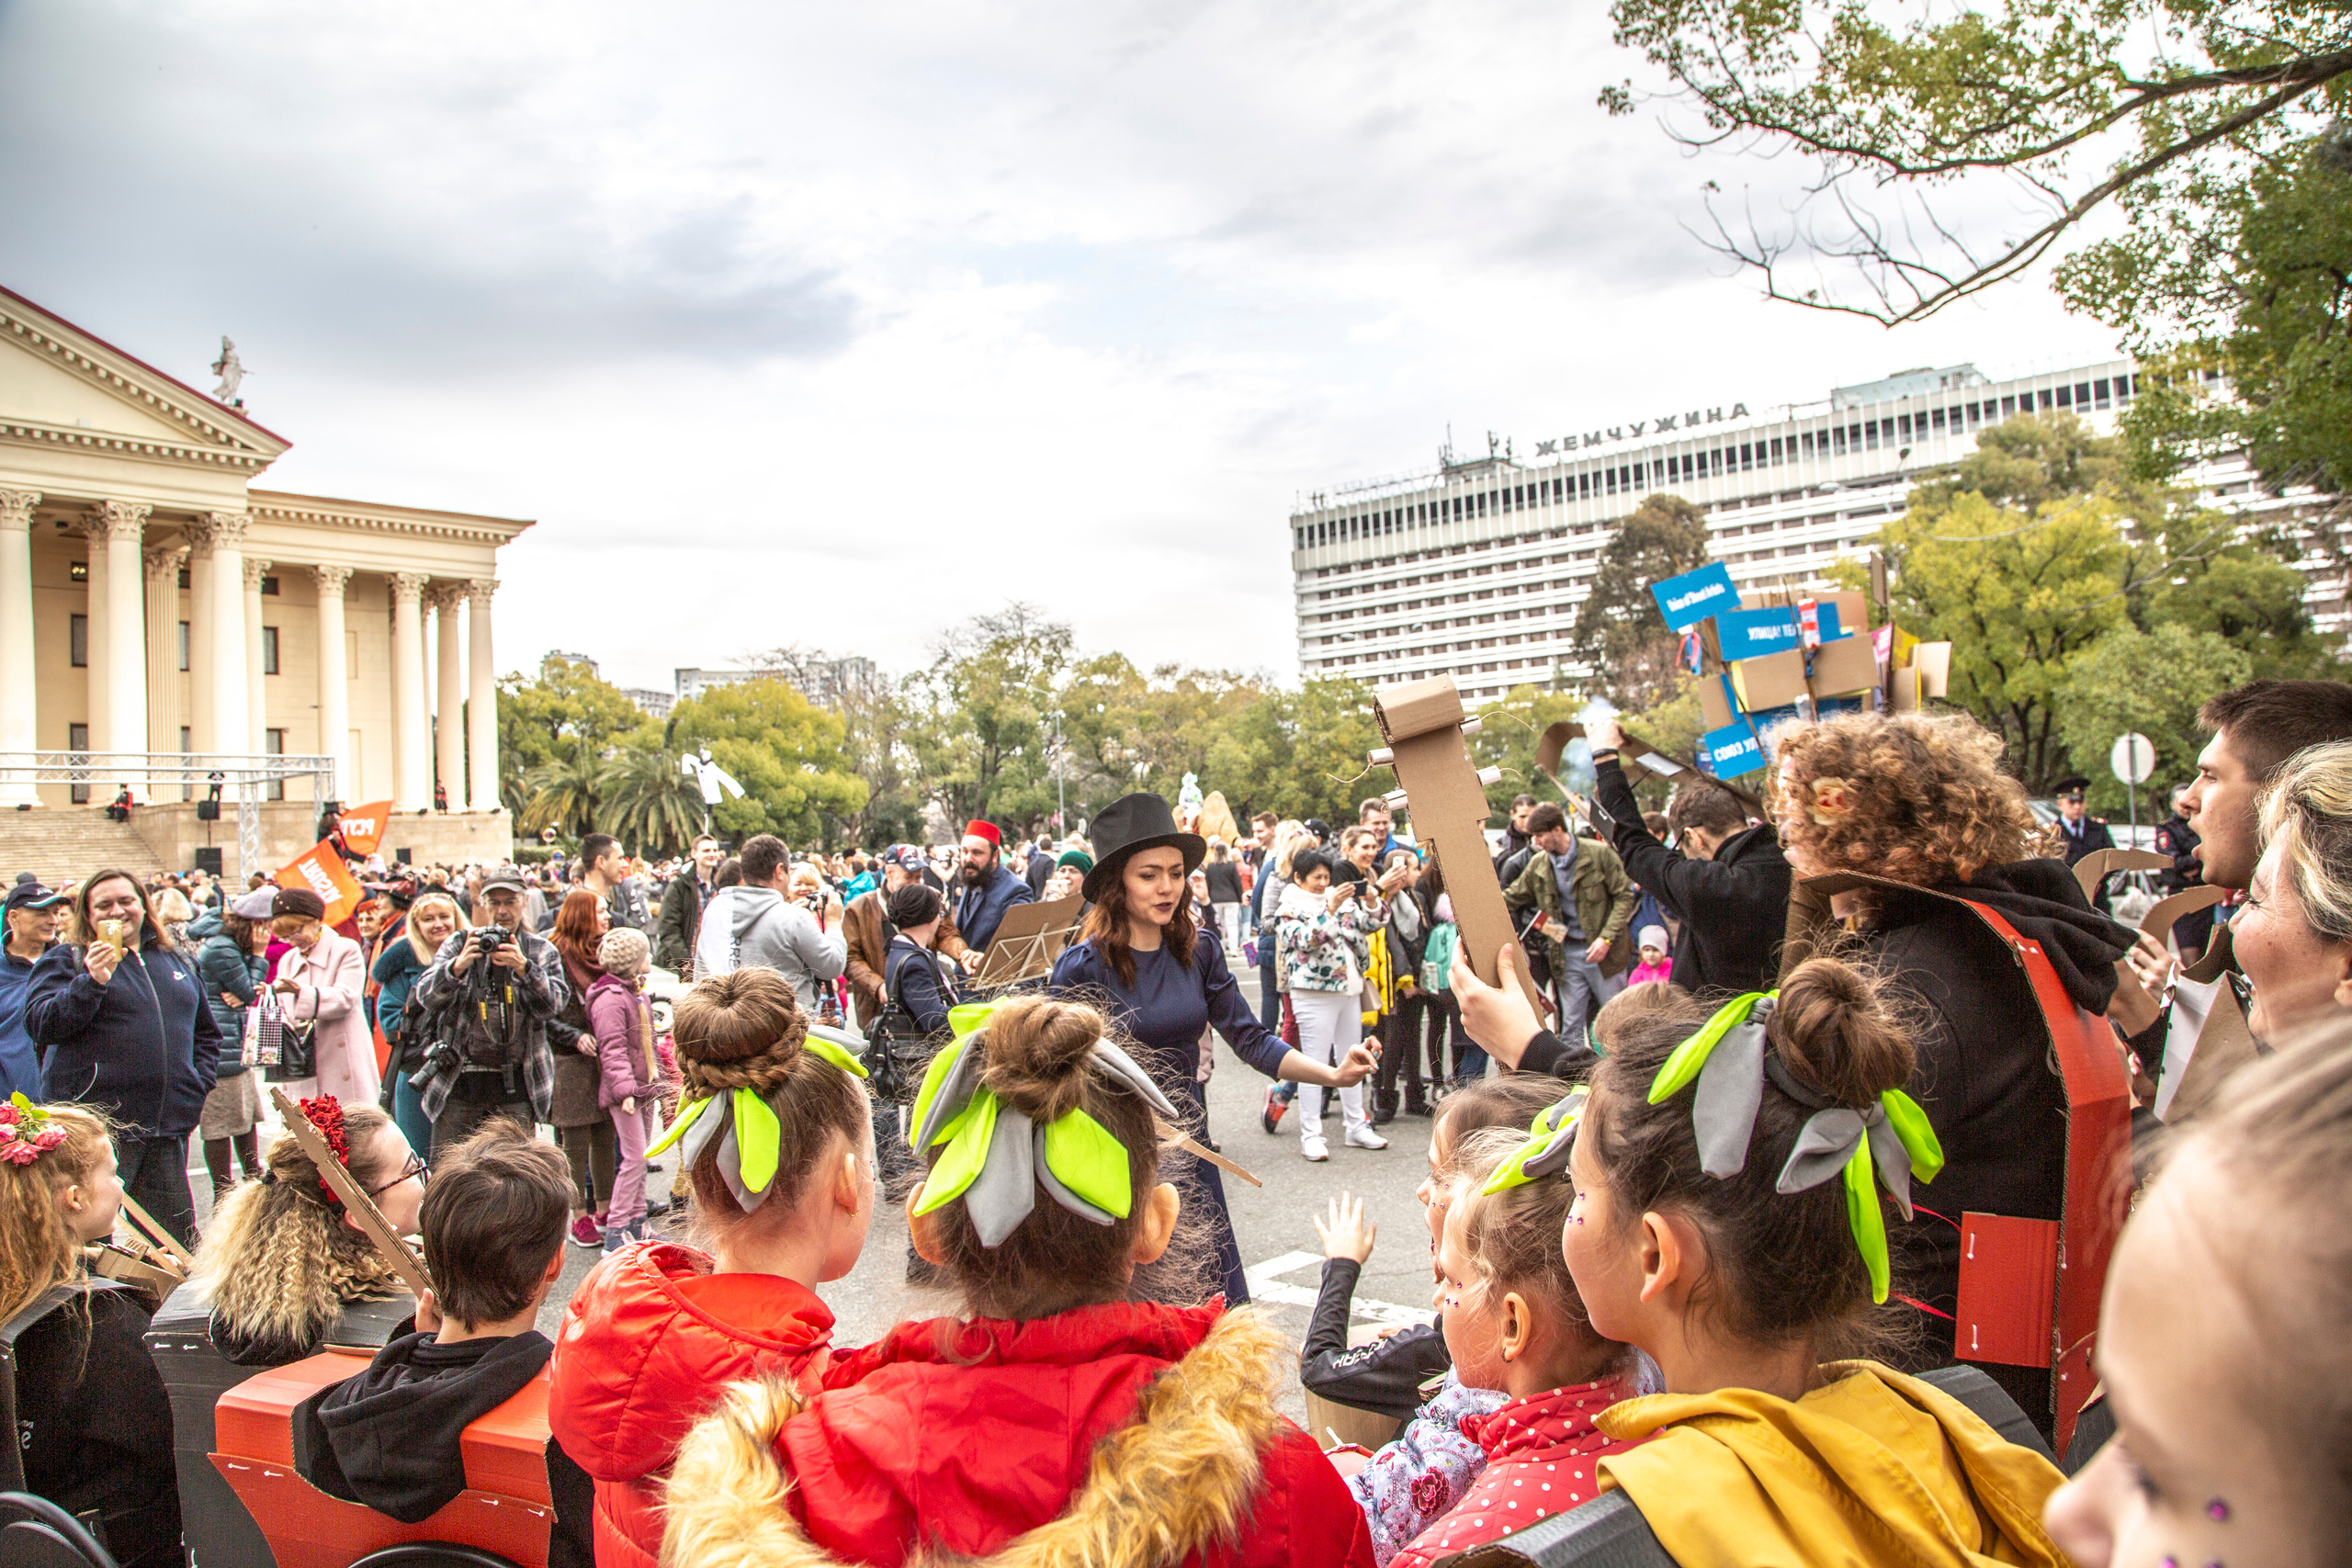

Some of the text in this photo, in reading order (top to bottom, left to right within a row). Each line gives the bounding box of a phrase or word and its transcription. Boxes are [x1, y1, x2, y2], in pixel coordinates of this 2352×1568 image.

[1535, 402, 1750, 457] ЖЕМЧУЖИНА
[1713, 741, 1744, 762] СОЮЗ
[1742, 737, 1759, 752] УЛ
